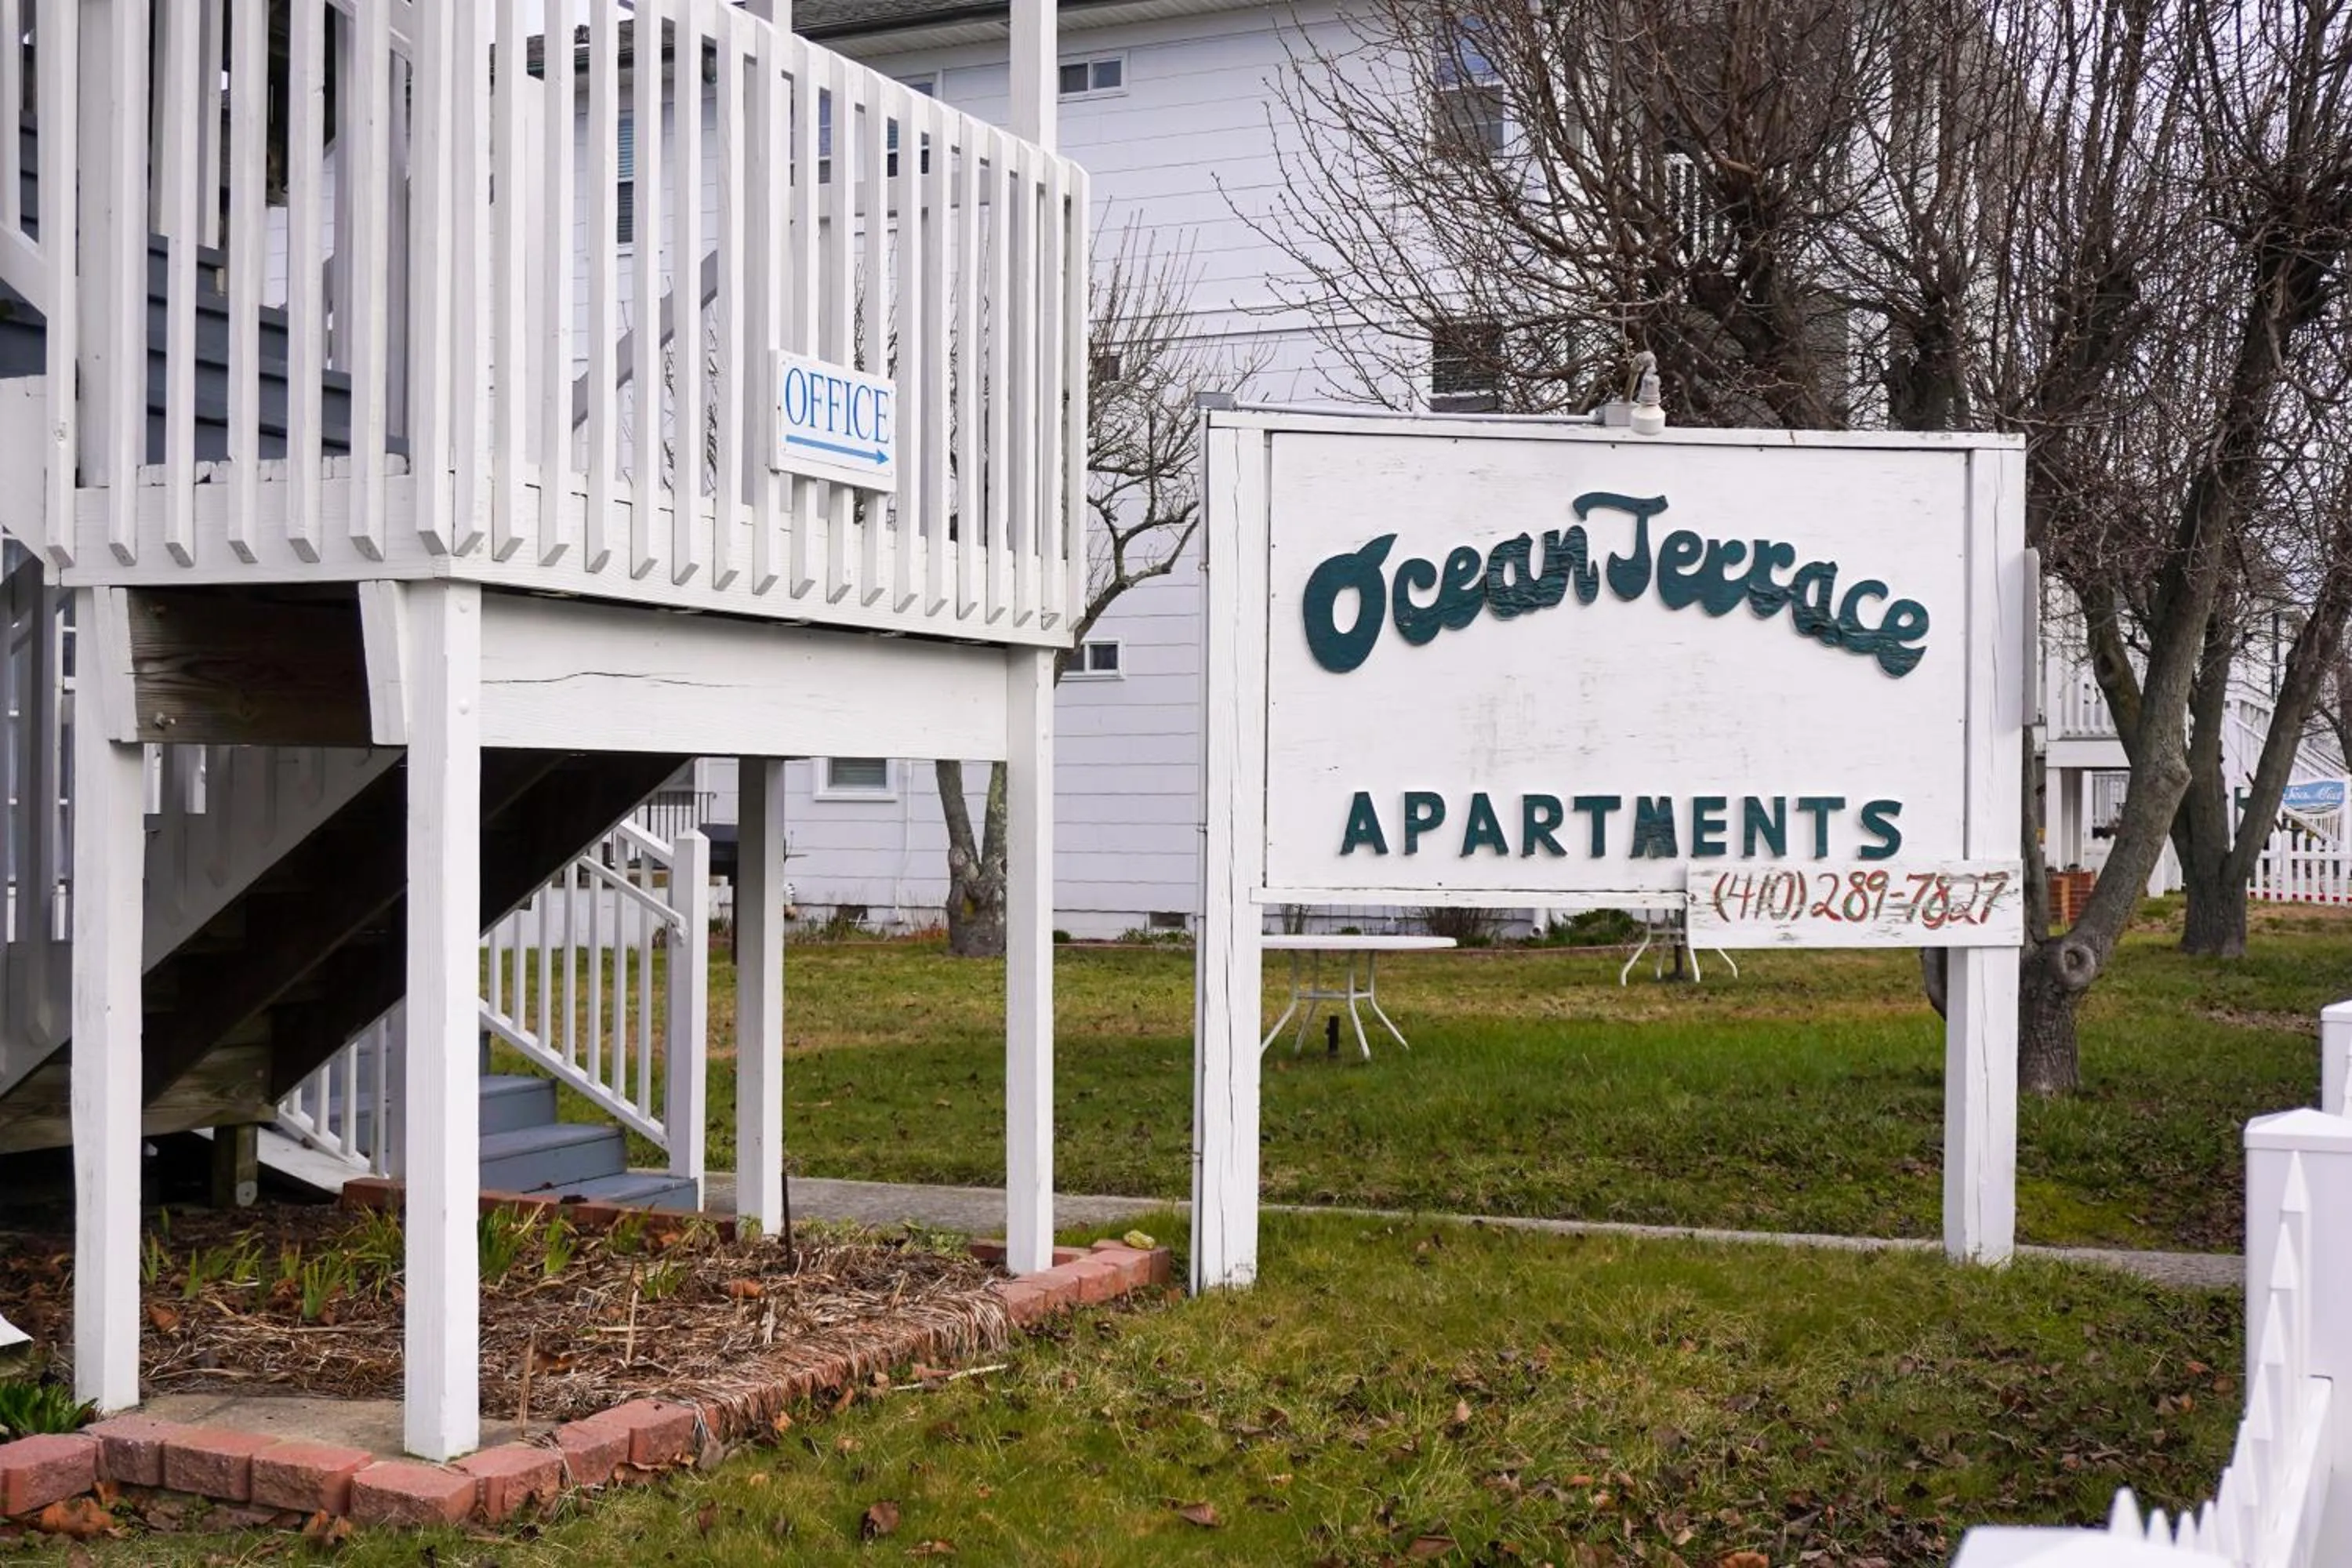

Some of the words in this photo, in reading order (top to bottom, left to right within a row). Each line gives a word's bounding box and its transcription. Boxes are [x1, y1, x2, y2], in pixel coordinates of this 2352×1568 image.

[785, 368, 889, 444] OFFICE
[1302, 524, 1600, 674] Ocean
[1571, 492, 1930, 679] Terrace
[1339, 791, 1903, 860] APARTMENTS
